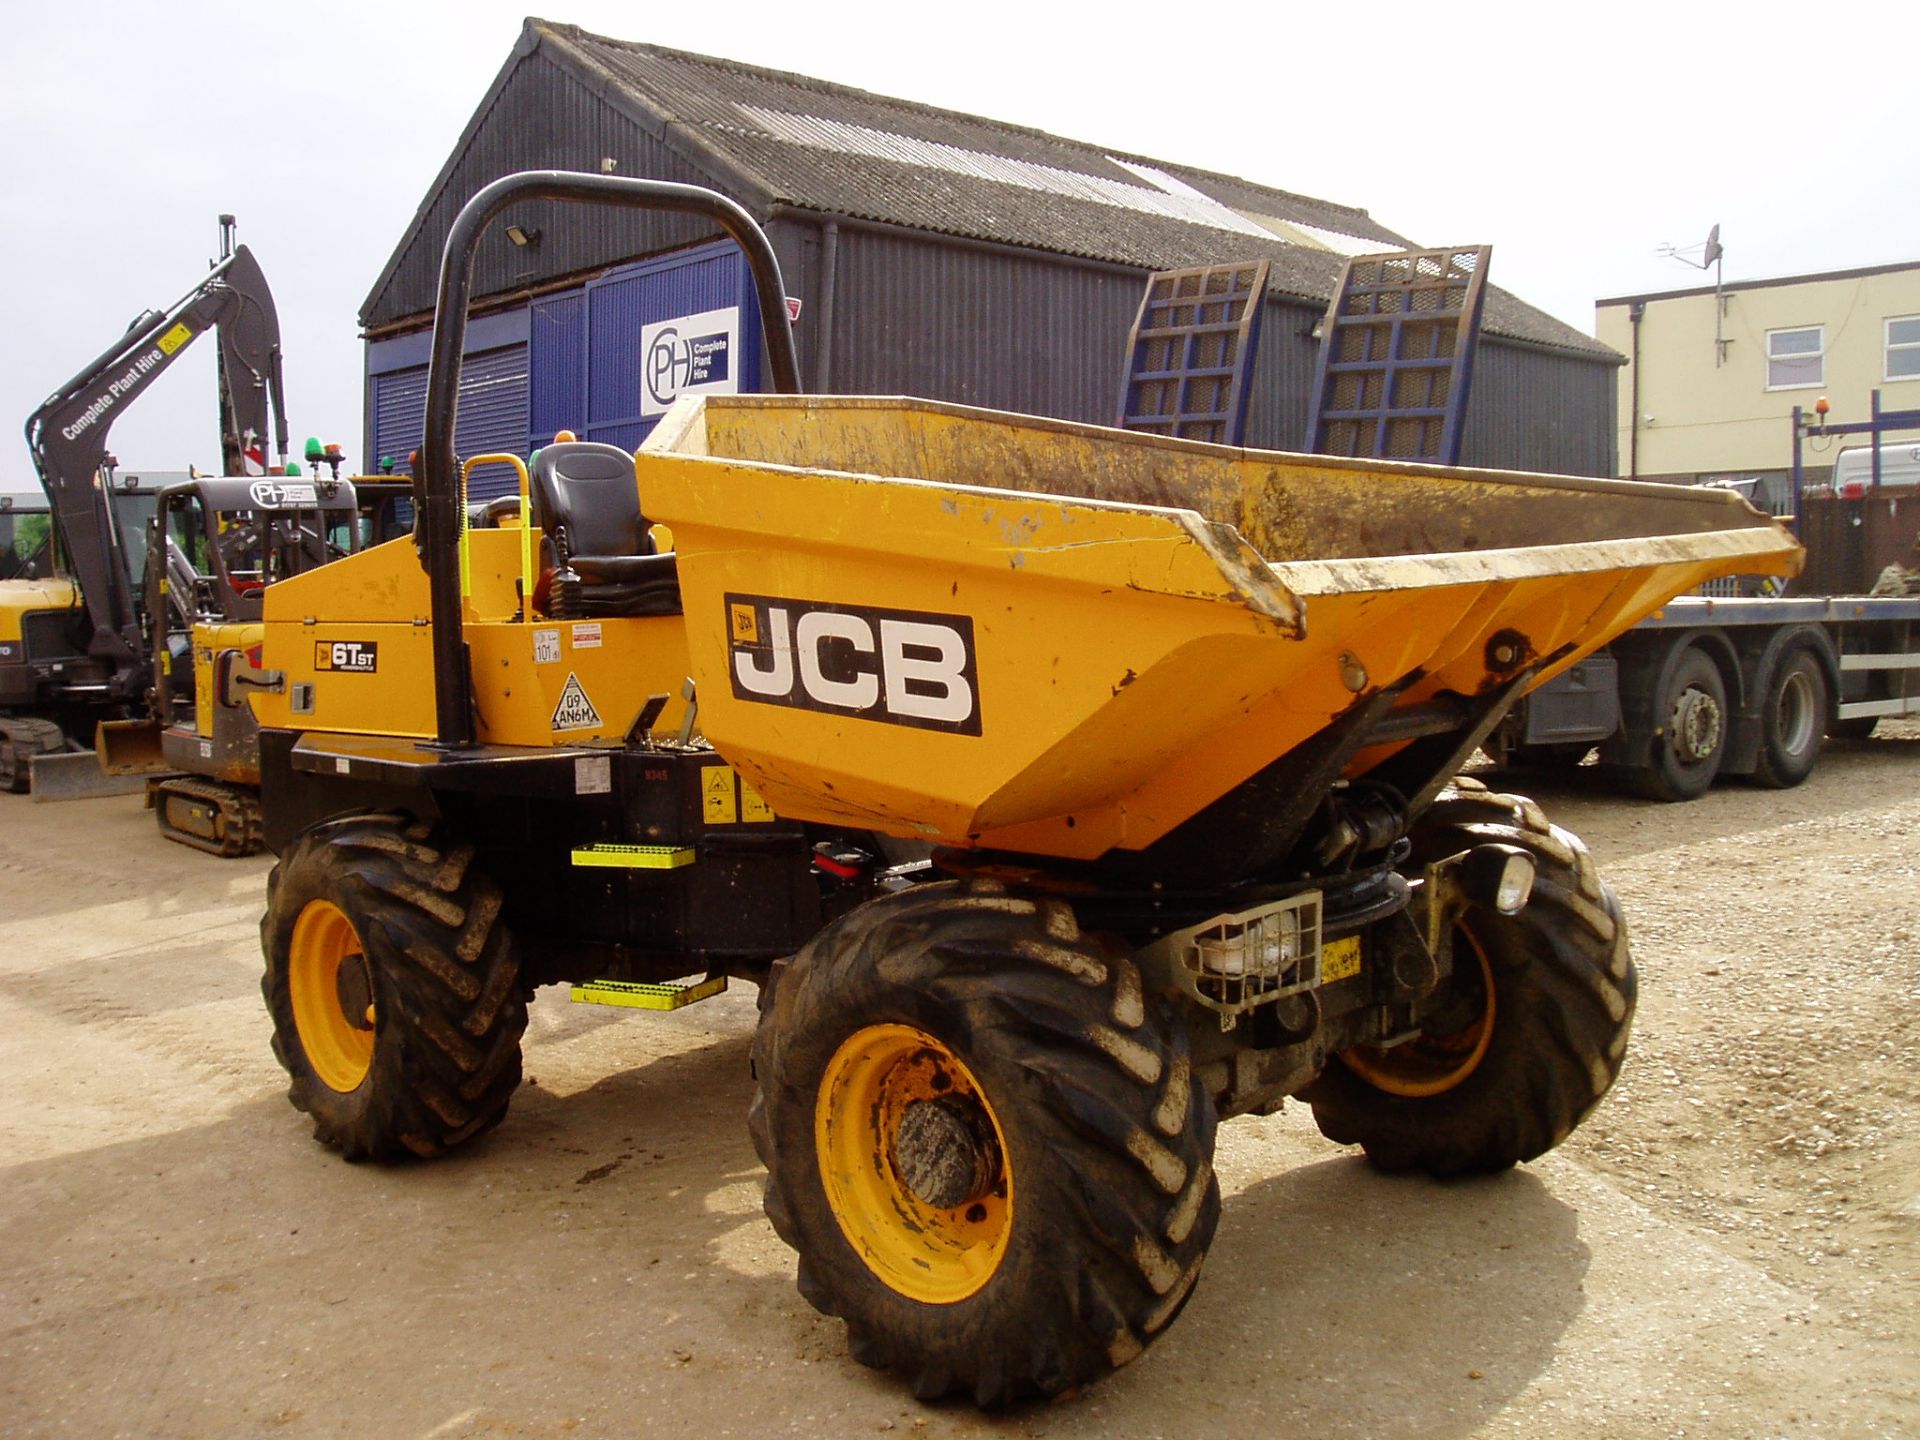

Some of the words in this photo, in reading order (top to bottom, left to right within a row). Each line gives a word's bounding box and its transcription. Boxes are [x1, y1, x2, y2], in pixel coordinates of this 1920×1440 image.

[693, 339, 727, 354] Complete
[693, 355, 712, 367] Plant
[693, 369, 708, 380] Hire
[62, 394, 113, 441] Complete
[108, 368, 141, 398] Plant
[135, 349, 162, 373] Hire
[537, 644, 551, 661] 101
[735, 607, 973, 722] JCB
